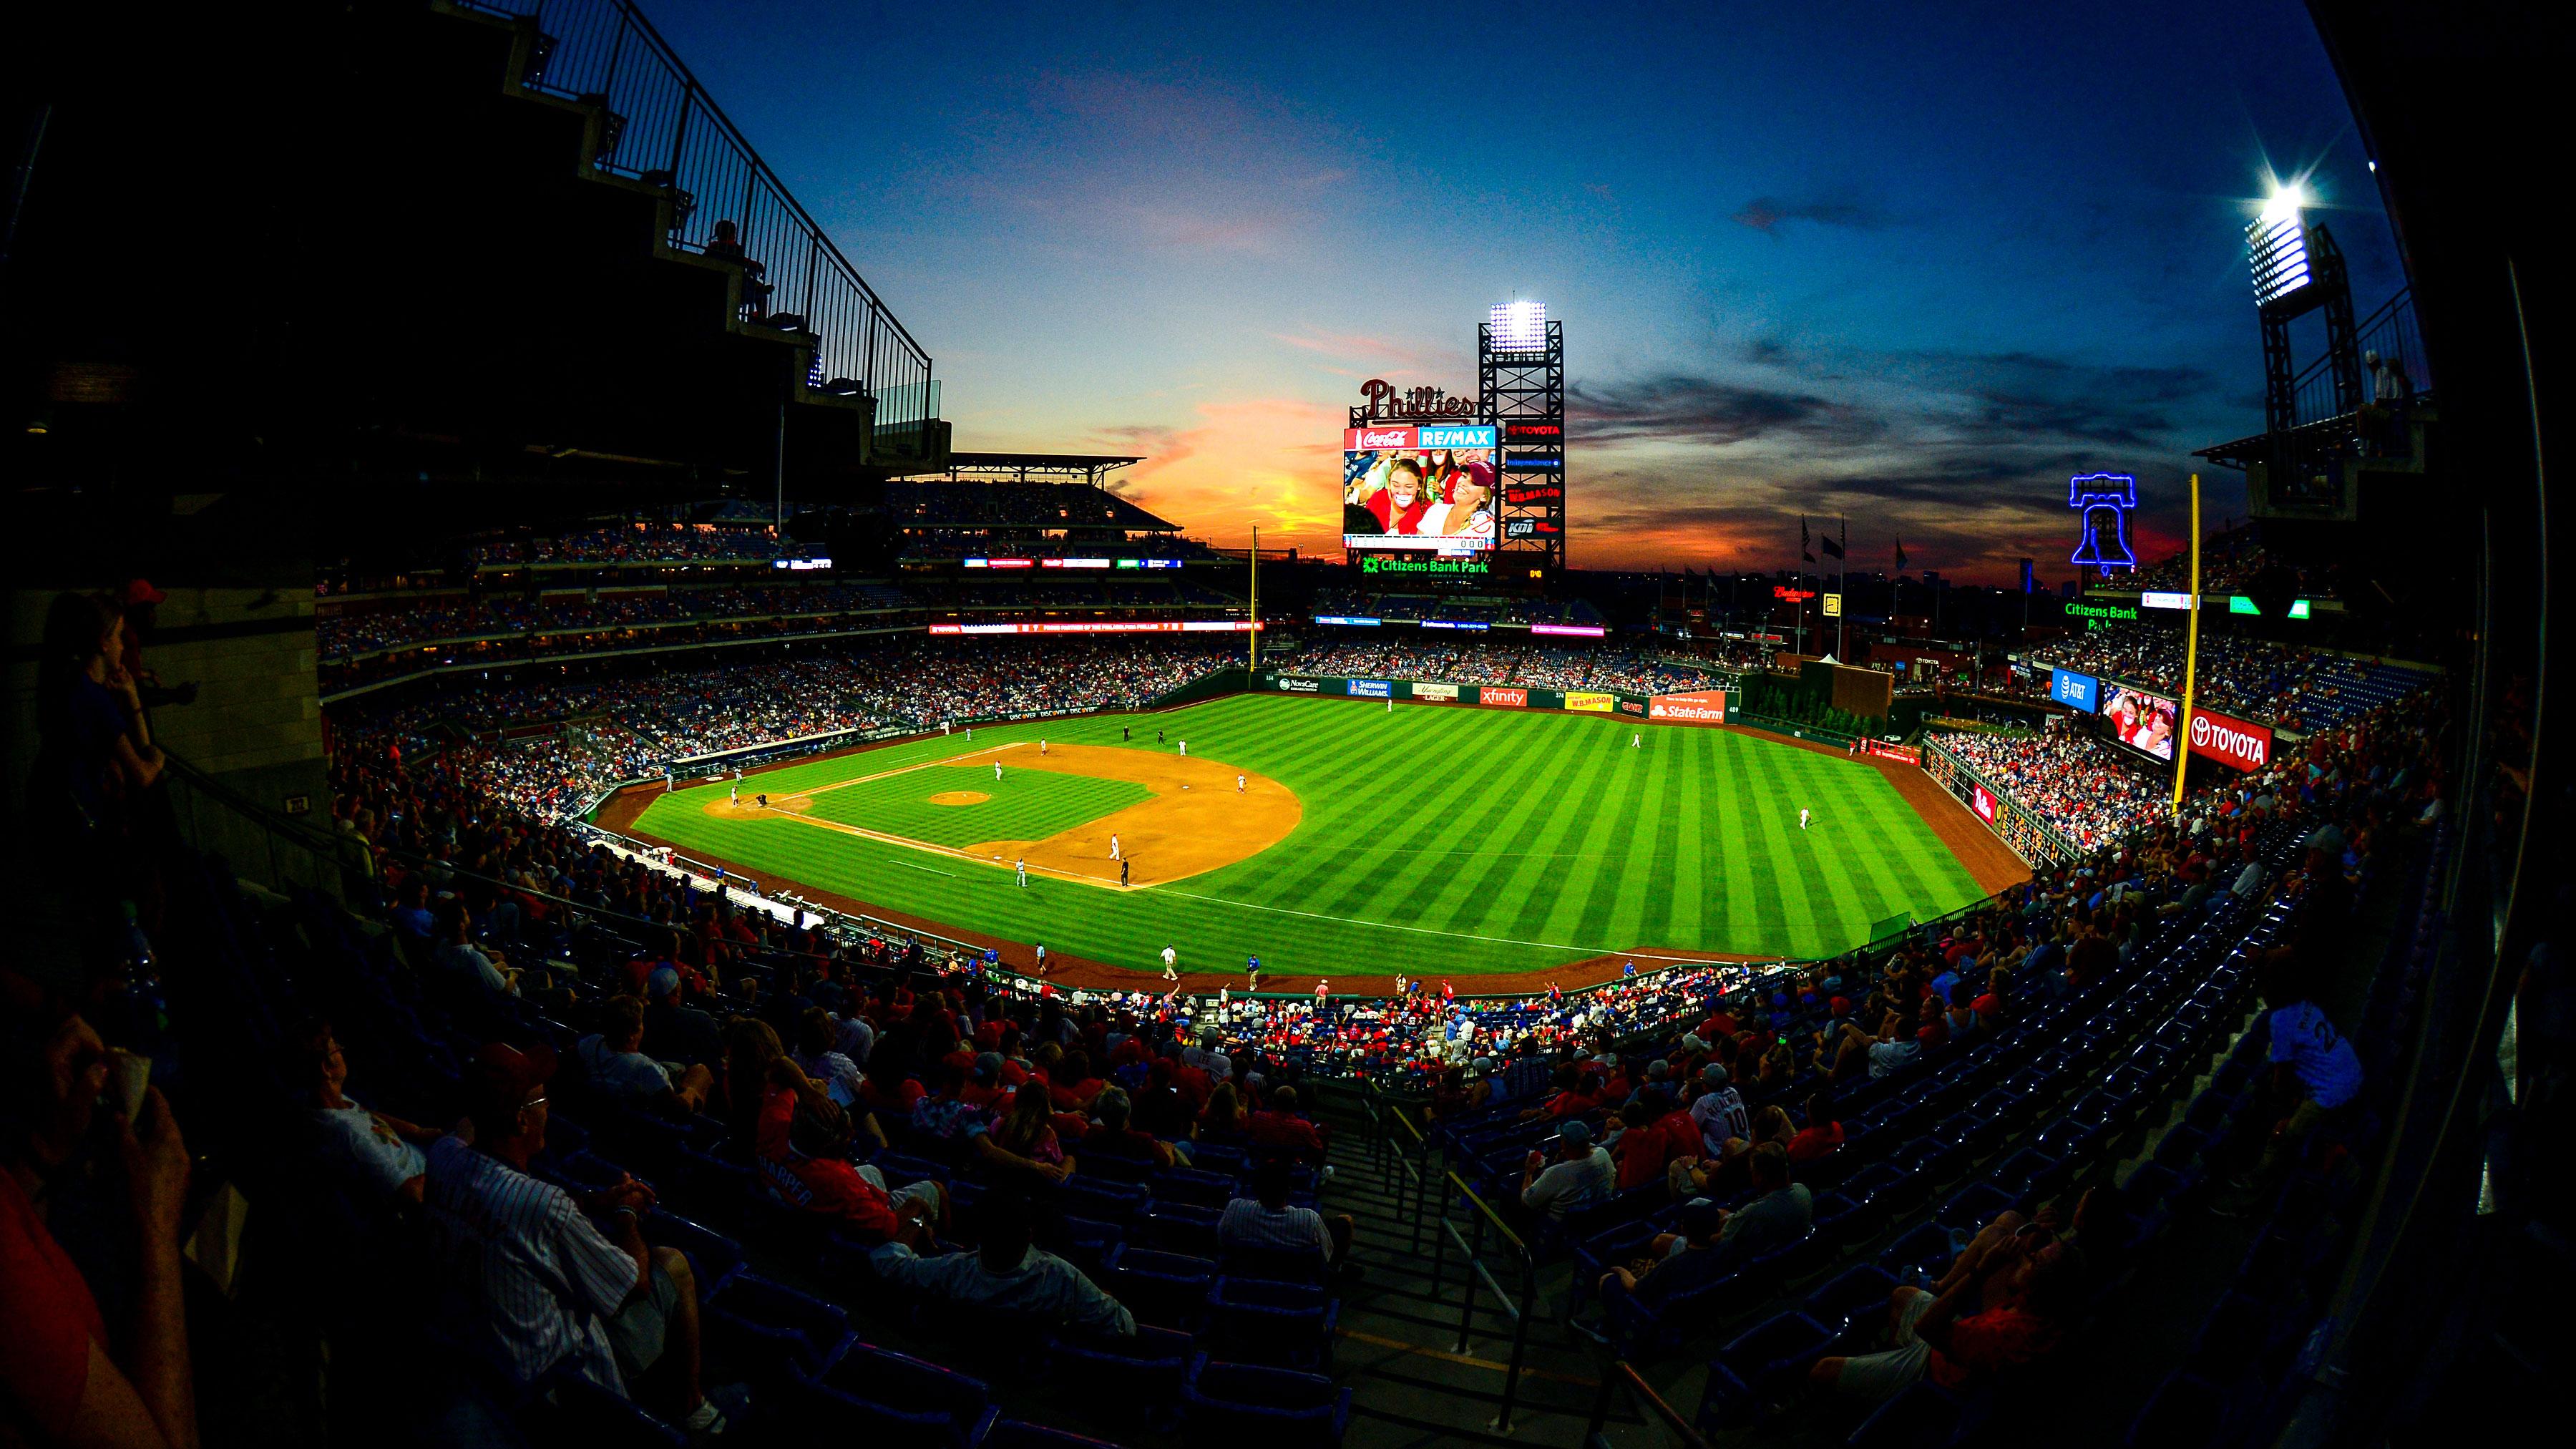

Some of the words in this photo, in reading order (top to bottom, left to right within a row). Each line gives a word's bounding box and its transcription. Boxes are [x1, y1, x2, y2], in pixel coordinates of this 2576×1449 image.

[1360, 379, 1476, 418] Phillies
[1521, 426, 1560, 435] TOYOTA
[1364, 431, 1408, 447] Coca-Cola
[1423, 431, 1491, 447] RE/MAX
[1381, 560, 1428, 572] Citizens
[1430, 562, 1460, 572] Bank
[1461, 562, 1488, 573] Park
[2065, 603, 2108, 618] Citizens
[2109, 606, 2138, 620] Bank
[1359, 680, 1387, 690] SHERWIN
[2069, 682, 2086, 701] AT&T
[1483, 689, 1524, 706] xfinity
[1040, 709, 1066, 718] DISCOVER
[1622, 701, 1643, 713] GIANT
[2211, 725, 2264, 766] TOYOTA
[1724, 1108, 1747, 1136] 10
[756, 1156, 814, 1208] HARPER
